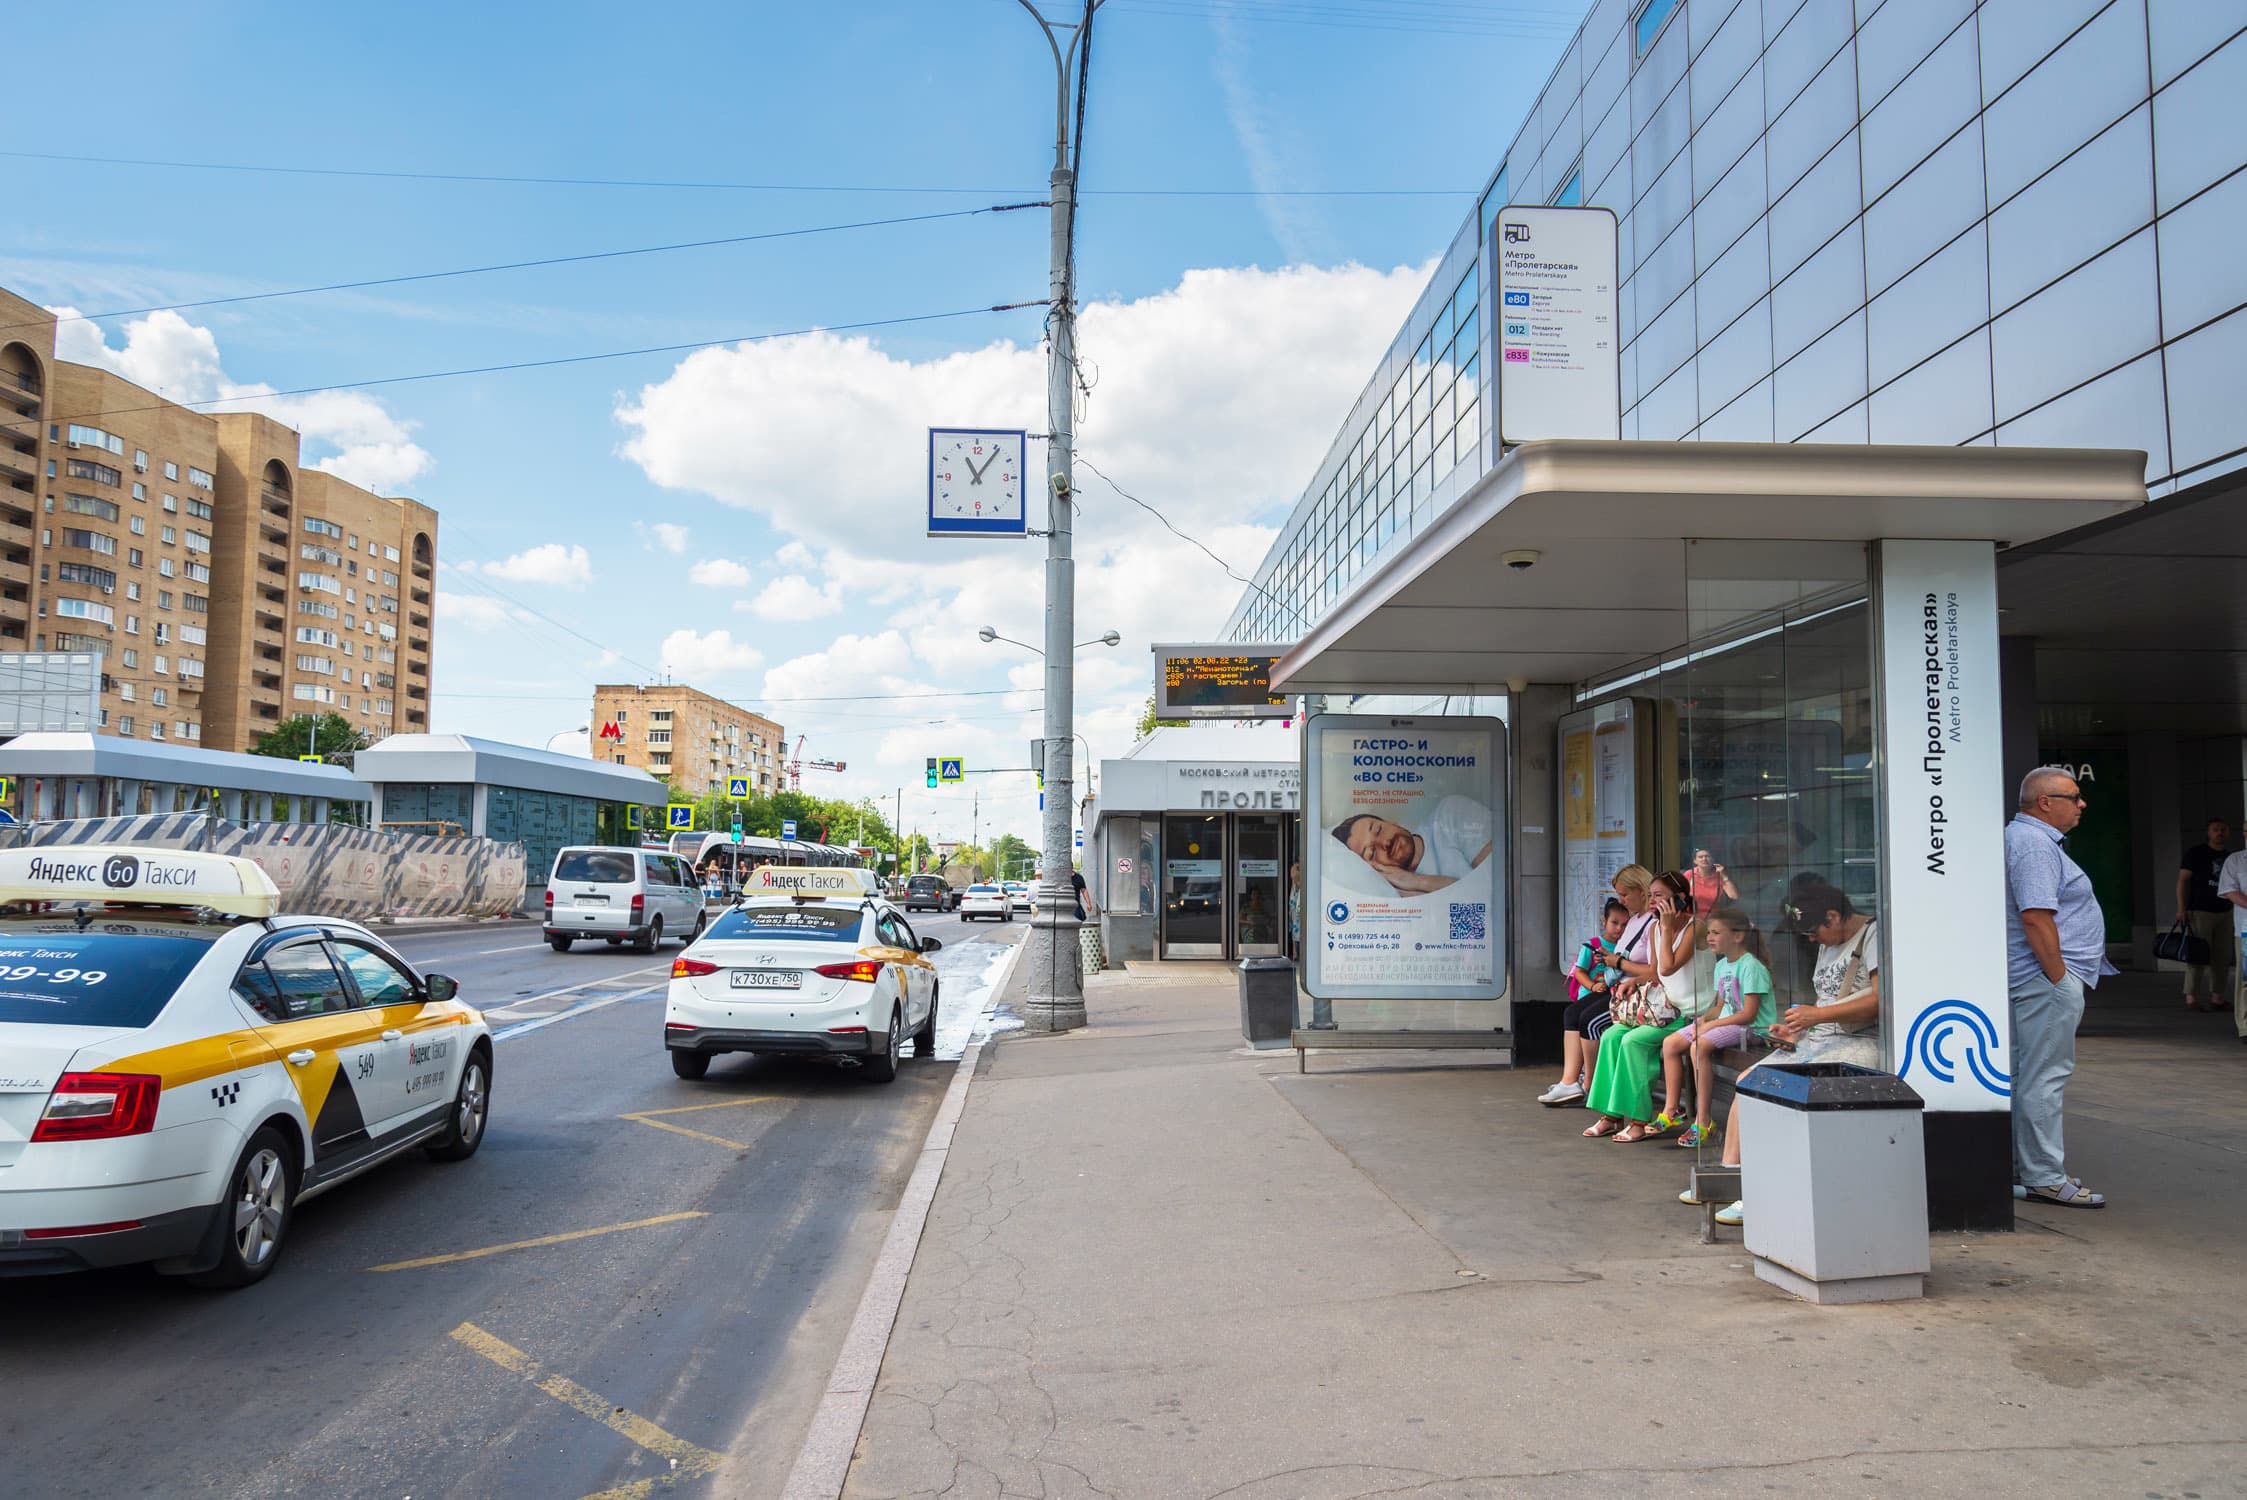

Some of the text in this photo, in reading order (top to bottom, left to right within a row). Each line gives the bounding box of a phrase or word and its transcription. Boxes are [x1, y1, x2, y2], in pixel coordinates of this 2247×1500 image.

[1505, 251, 1535, 260] Метро
[1505, 260, 1578, 270] «Пролетарская»
[1509, 325, 1525, 334] 012
[972, 446, 983, 455] 12
[944, 472, 1009, 482] 9 3
[974, 501, 982, 510] 6
[1167, 657, 1189, 665] 11:06
[1946, 592, 1961, 742] Metro Proletarskaya
[1923, 592, 1947, 876] Метро «Пролетарская»
[1353, 739, 1428, 750] ГАСТРО- И
[1353, 755, 1476, 767] КОЛОНОСКОПИЯ
[1180, 768, 1249, 777] МОСКОВСКИЙ
[1353, 772, 1424, 783] «ВО СНЕ»
[1200, 790, 1299, 808] ПРОЛЕТ
[28, 857, 197, 886] Яндекс Go Такси
[763, 871, 844, 889] Яндекс Такси
[1344, 932, 1364, 941] (499)
[0, 948, 80, 960] екс Такси
[735, 973, 798, 985] К730ХЕ 750
[358, 1053, 375, 1079] 549
